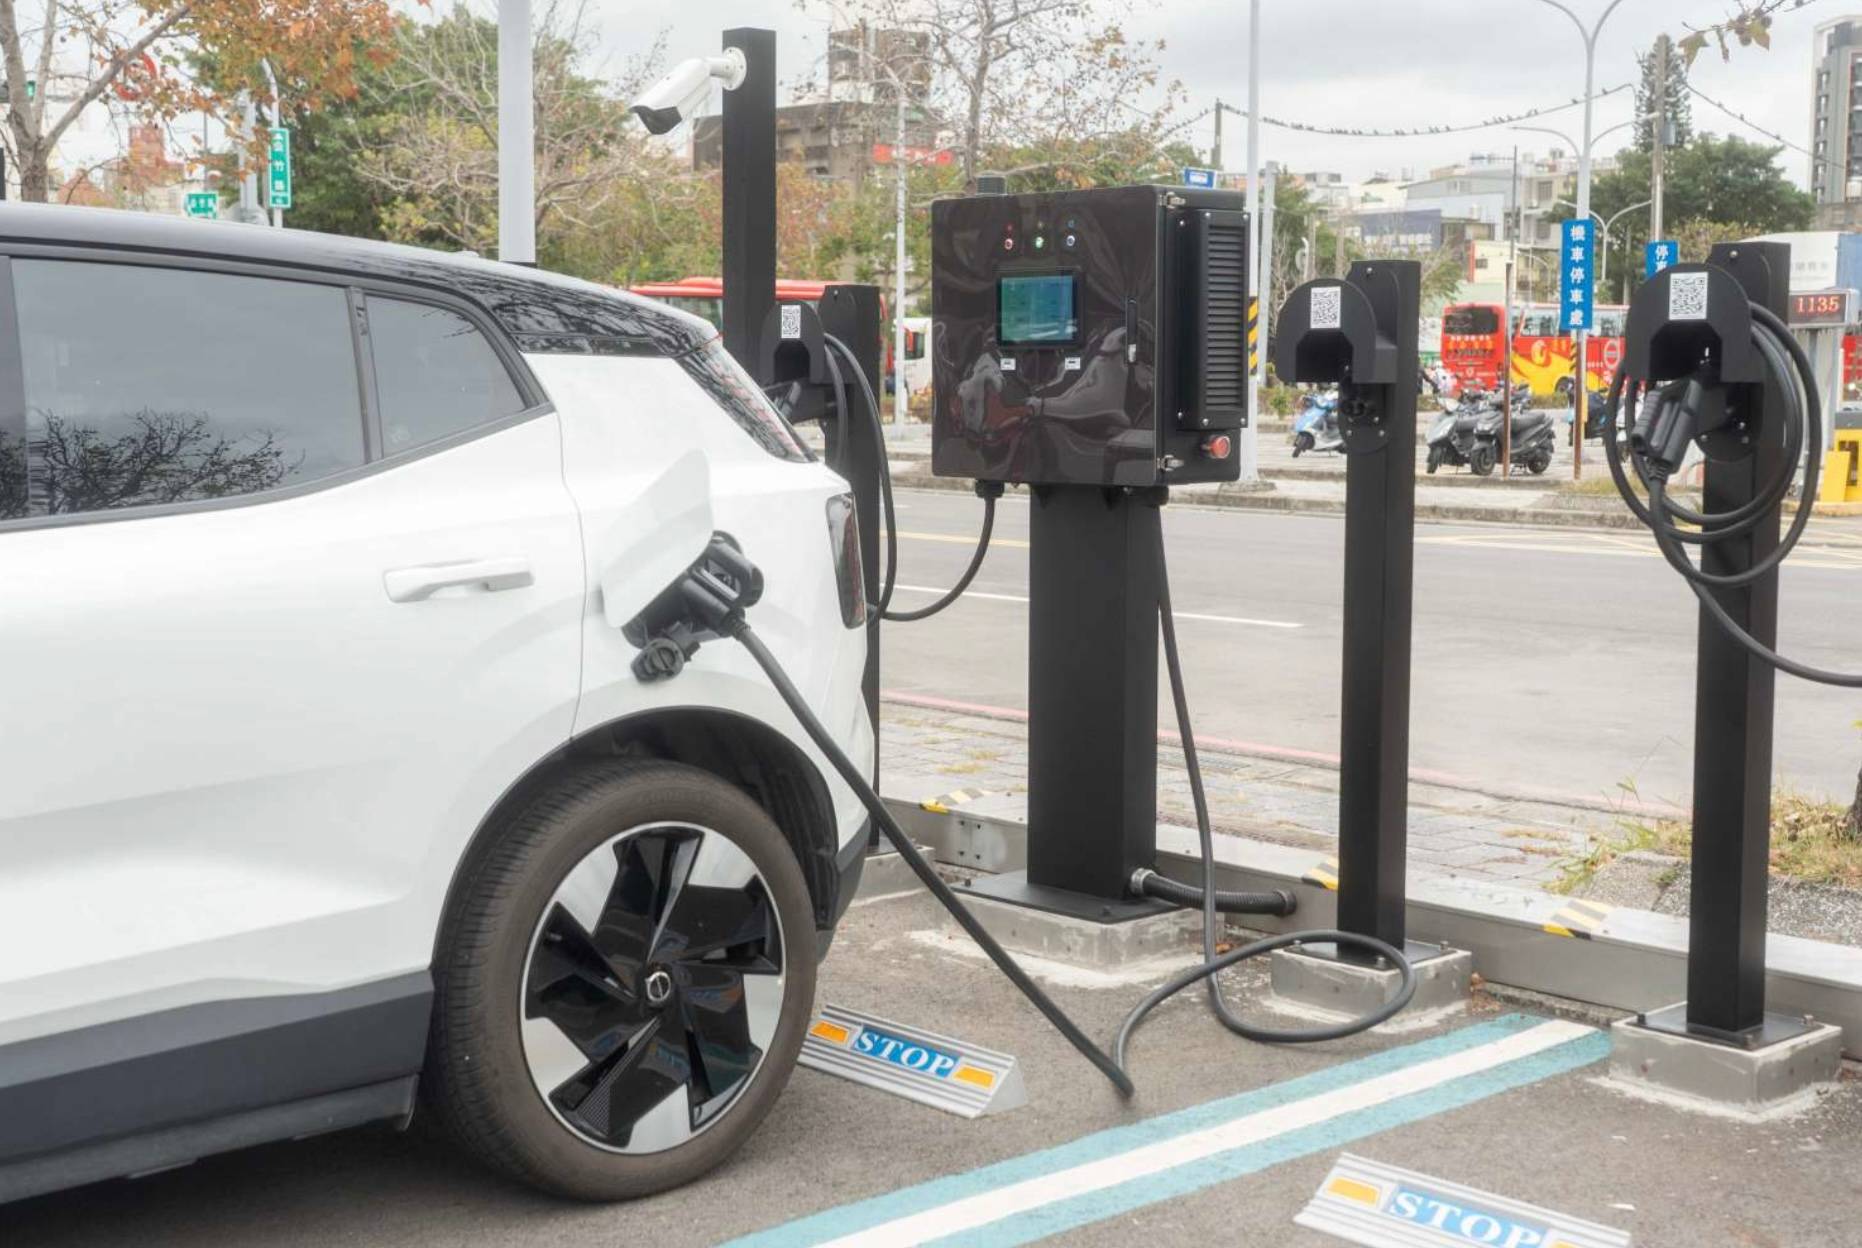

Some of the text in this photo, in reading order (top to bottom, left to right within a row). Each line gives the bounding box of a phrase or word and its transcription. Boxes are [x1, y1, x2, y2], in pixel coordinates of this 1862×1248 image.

[1569, 225, 1585, 326] 機車停車處
[1797, 296, 1840, 313] 1135
[855, 1032, 956, 1075] STOP
[1390, 1191, 1541, 1248] STOP
